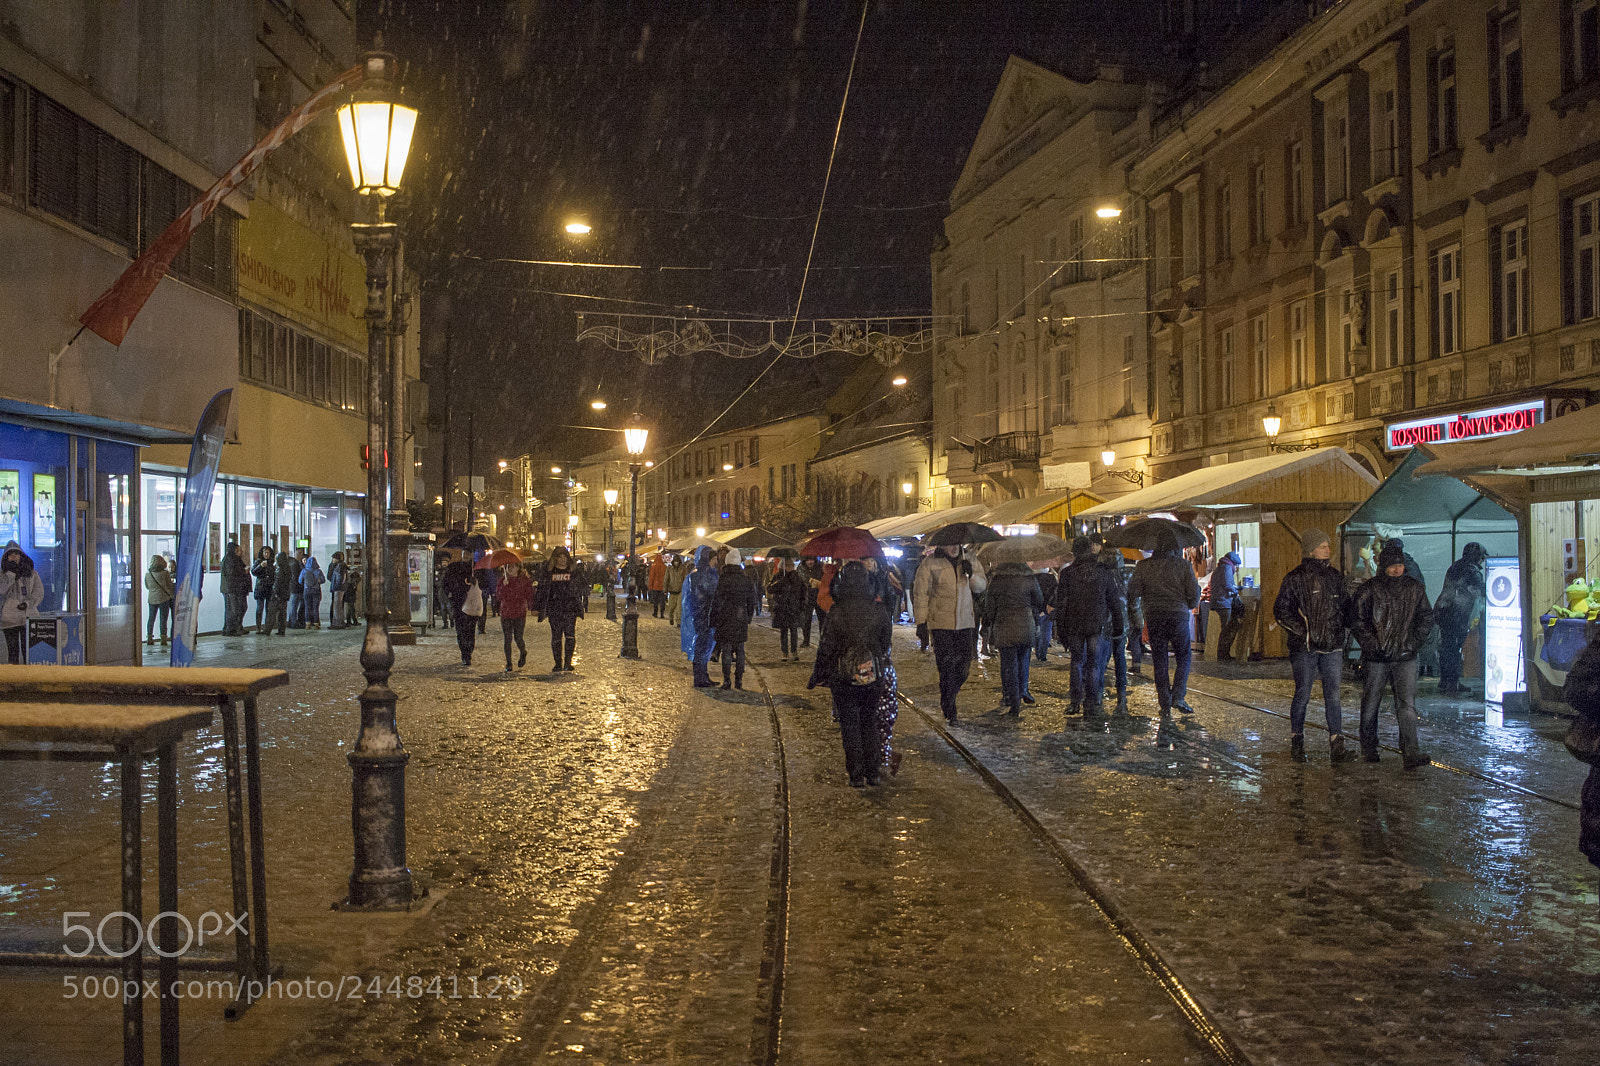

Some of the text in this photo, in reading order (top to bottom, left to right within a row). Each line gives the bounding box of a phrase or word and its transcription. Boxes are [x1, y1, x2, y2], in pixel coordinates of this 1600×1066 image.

[273, 270, 296, 298] SHOP
[1391, 409, 1536, 447] KOSSUTH KÖNYVESBOLT
